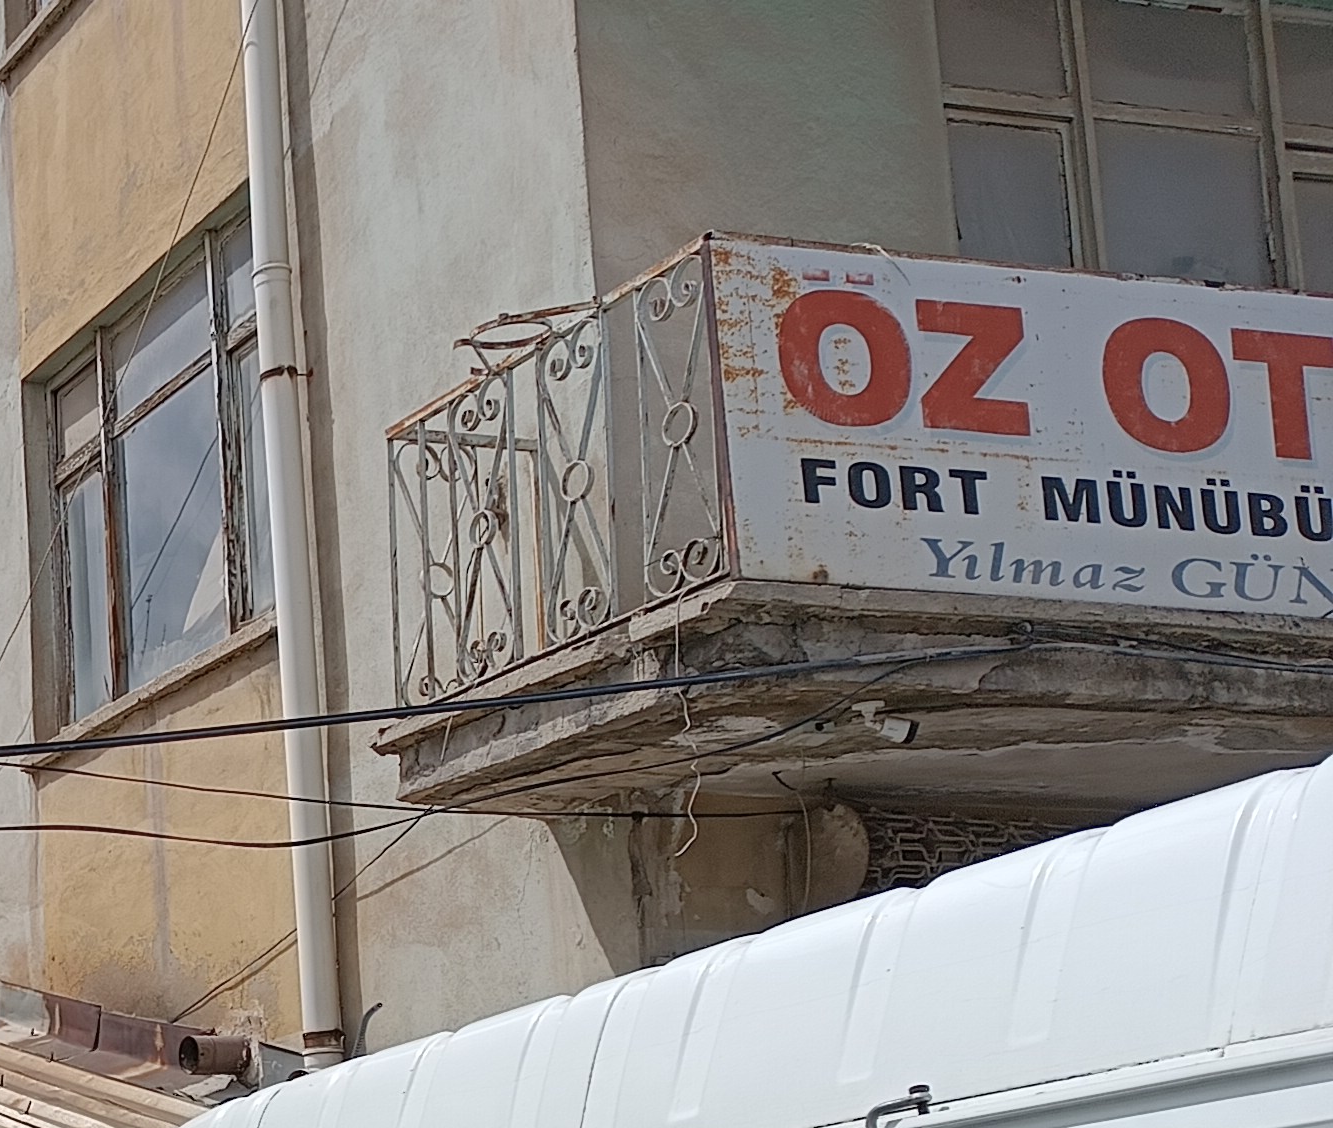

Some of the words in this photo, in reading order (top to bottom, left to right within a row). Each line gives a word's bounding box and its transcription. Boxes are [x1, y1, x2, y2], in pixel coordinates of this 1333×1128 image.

[778, 269, 1031, 436] ÖZ
[799, 457, 988, 515] FORT
[1040, 470, 1333, 542] MÜNÜBÜ
[920, 537, 1147, 593] Yılmaz
[1171, 554, 1333, 605] GÜN
